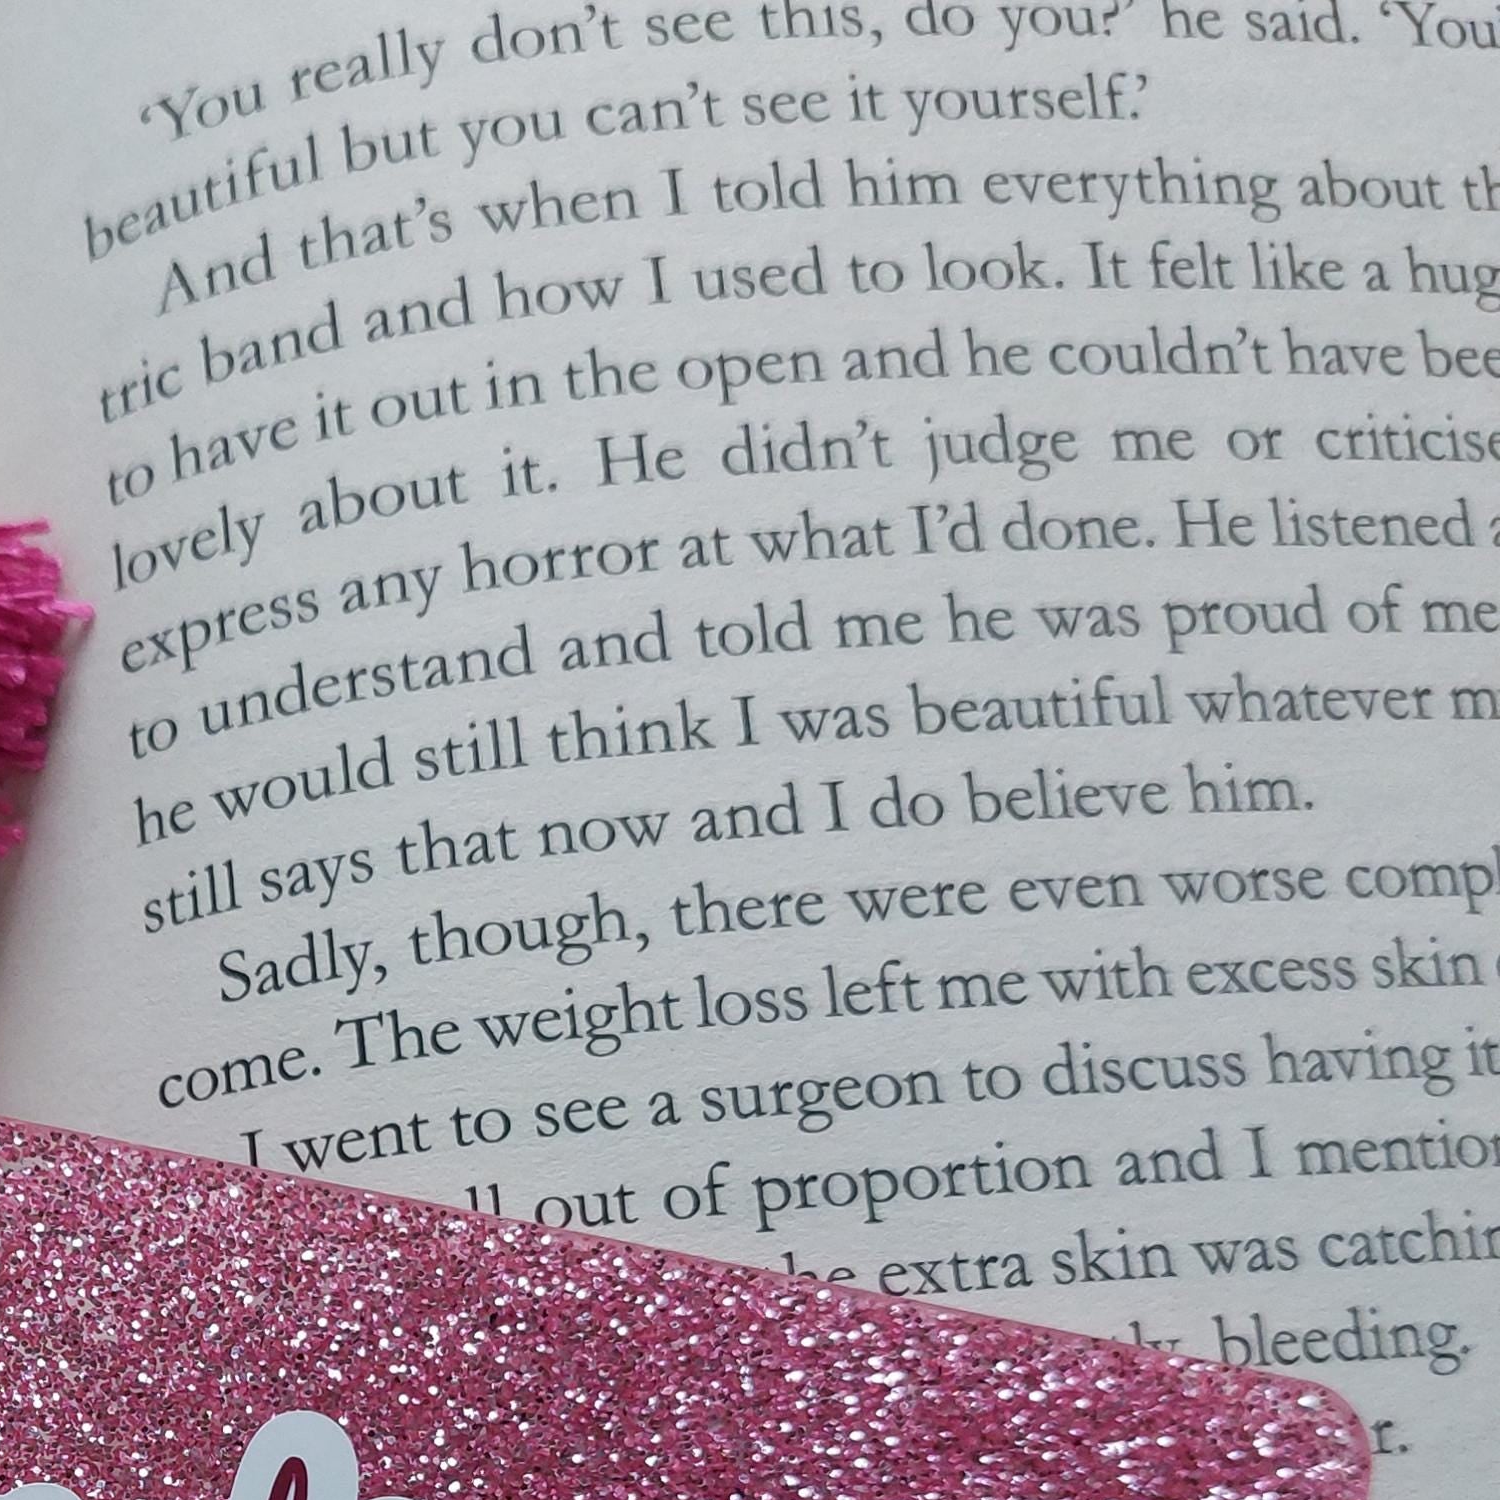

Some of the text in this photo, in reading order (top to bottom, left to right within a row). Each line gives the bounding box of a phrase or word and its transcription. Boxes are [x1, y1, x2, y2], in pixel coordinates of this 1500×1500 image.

[340, 70, 1148, 174] but you can’t see it yourself.’
[99, 239, 1392, 424] tric band and how I used to look. It felt like a
[121, 495, 1477, 674] express any horror at what I’d done. He listened
[128, 582, 1404, 760] to understand and told me he was proud of
[158, 935, 1487, 1109] come. The weight loss left me with excess skin
[534, 1183, 640, 1230] out
[663, 1160, 731, 1221] of
[750, 1140, 1094, 1234] proportion
[1115, 1125, 1226, 1187] and
[1241, 1123, 1274, 1179] I
[878, 1251, 1035, 1297] extra
[1051, 1226, 1179, 1286] skin
[1187, 1235, 1302, 1276] was
[1211, 1305, 1473, 1377] bleeding.
